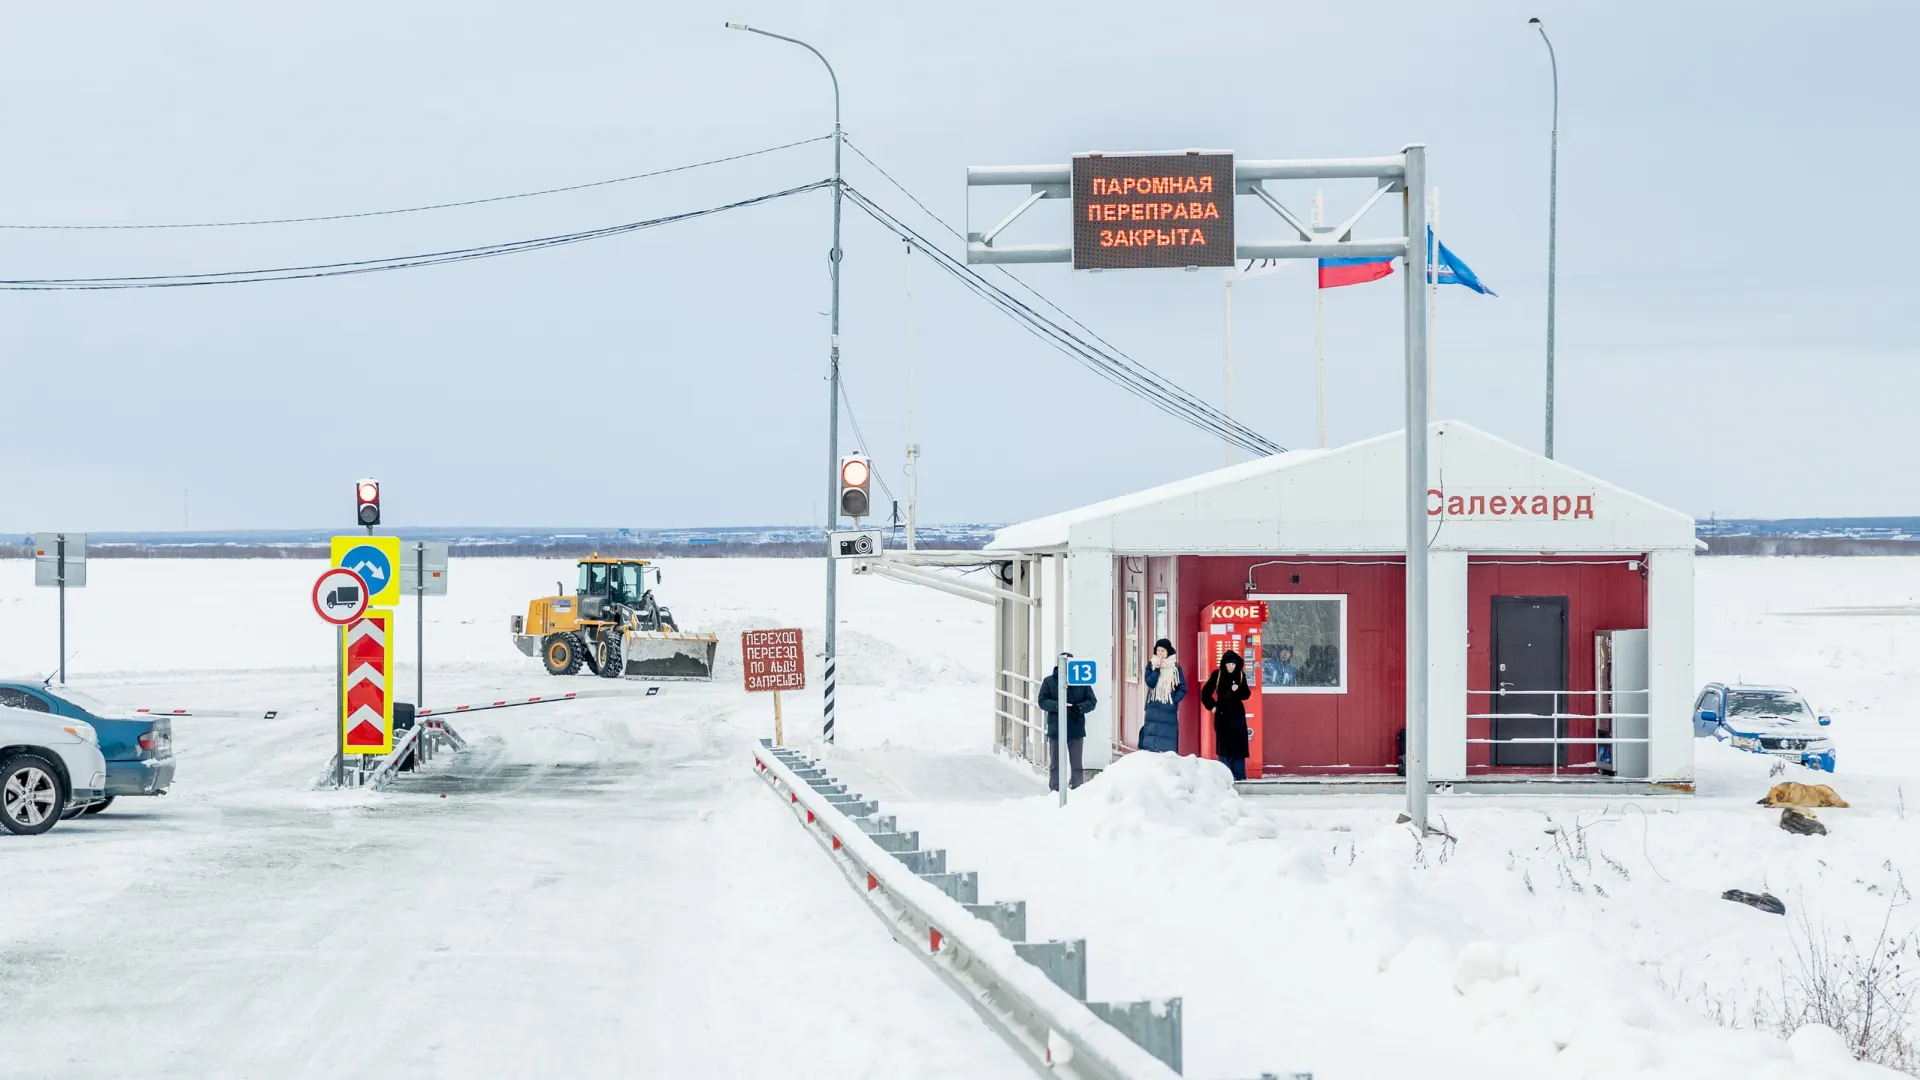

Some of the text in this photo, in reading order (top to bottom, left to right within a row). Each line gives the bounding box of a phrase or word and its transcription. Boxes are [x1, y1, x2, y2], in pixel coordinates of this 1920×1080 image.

[1093, 175, 1213, 195] ПАРОМНАЯ
[1088, 202, 1219, 221] ПЕРЕПРАВА
[1100, 228, 1206, 247] ЗАКРЫТА
[1427, 489, 1594, 520] Салехард
[1212, 606, 1259, 618] КОФЕ
[746, 631, 797, 645] ПЕРЕХОД
[747, 646, 798, 660] ПЕРЕЕЗД
[750, 660, 796, 673] ПО ЛЬДУ
[1072, 664, 1092, 681] 13
[748, 673, 803, 688] ЗАПРЕЩЕН
